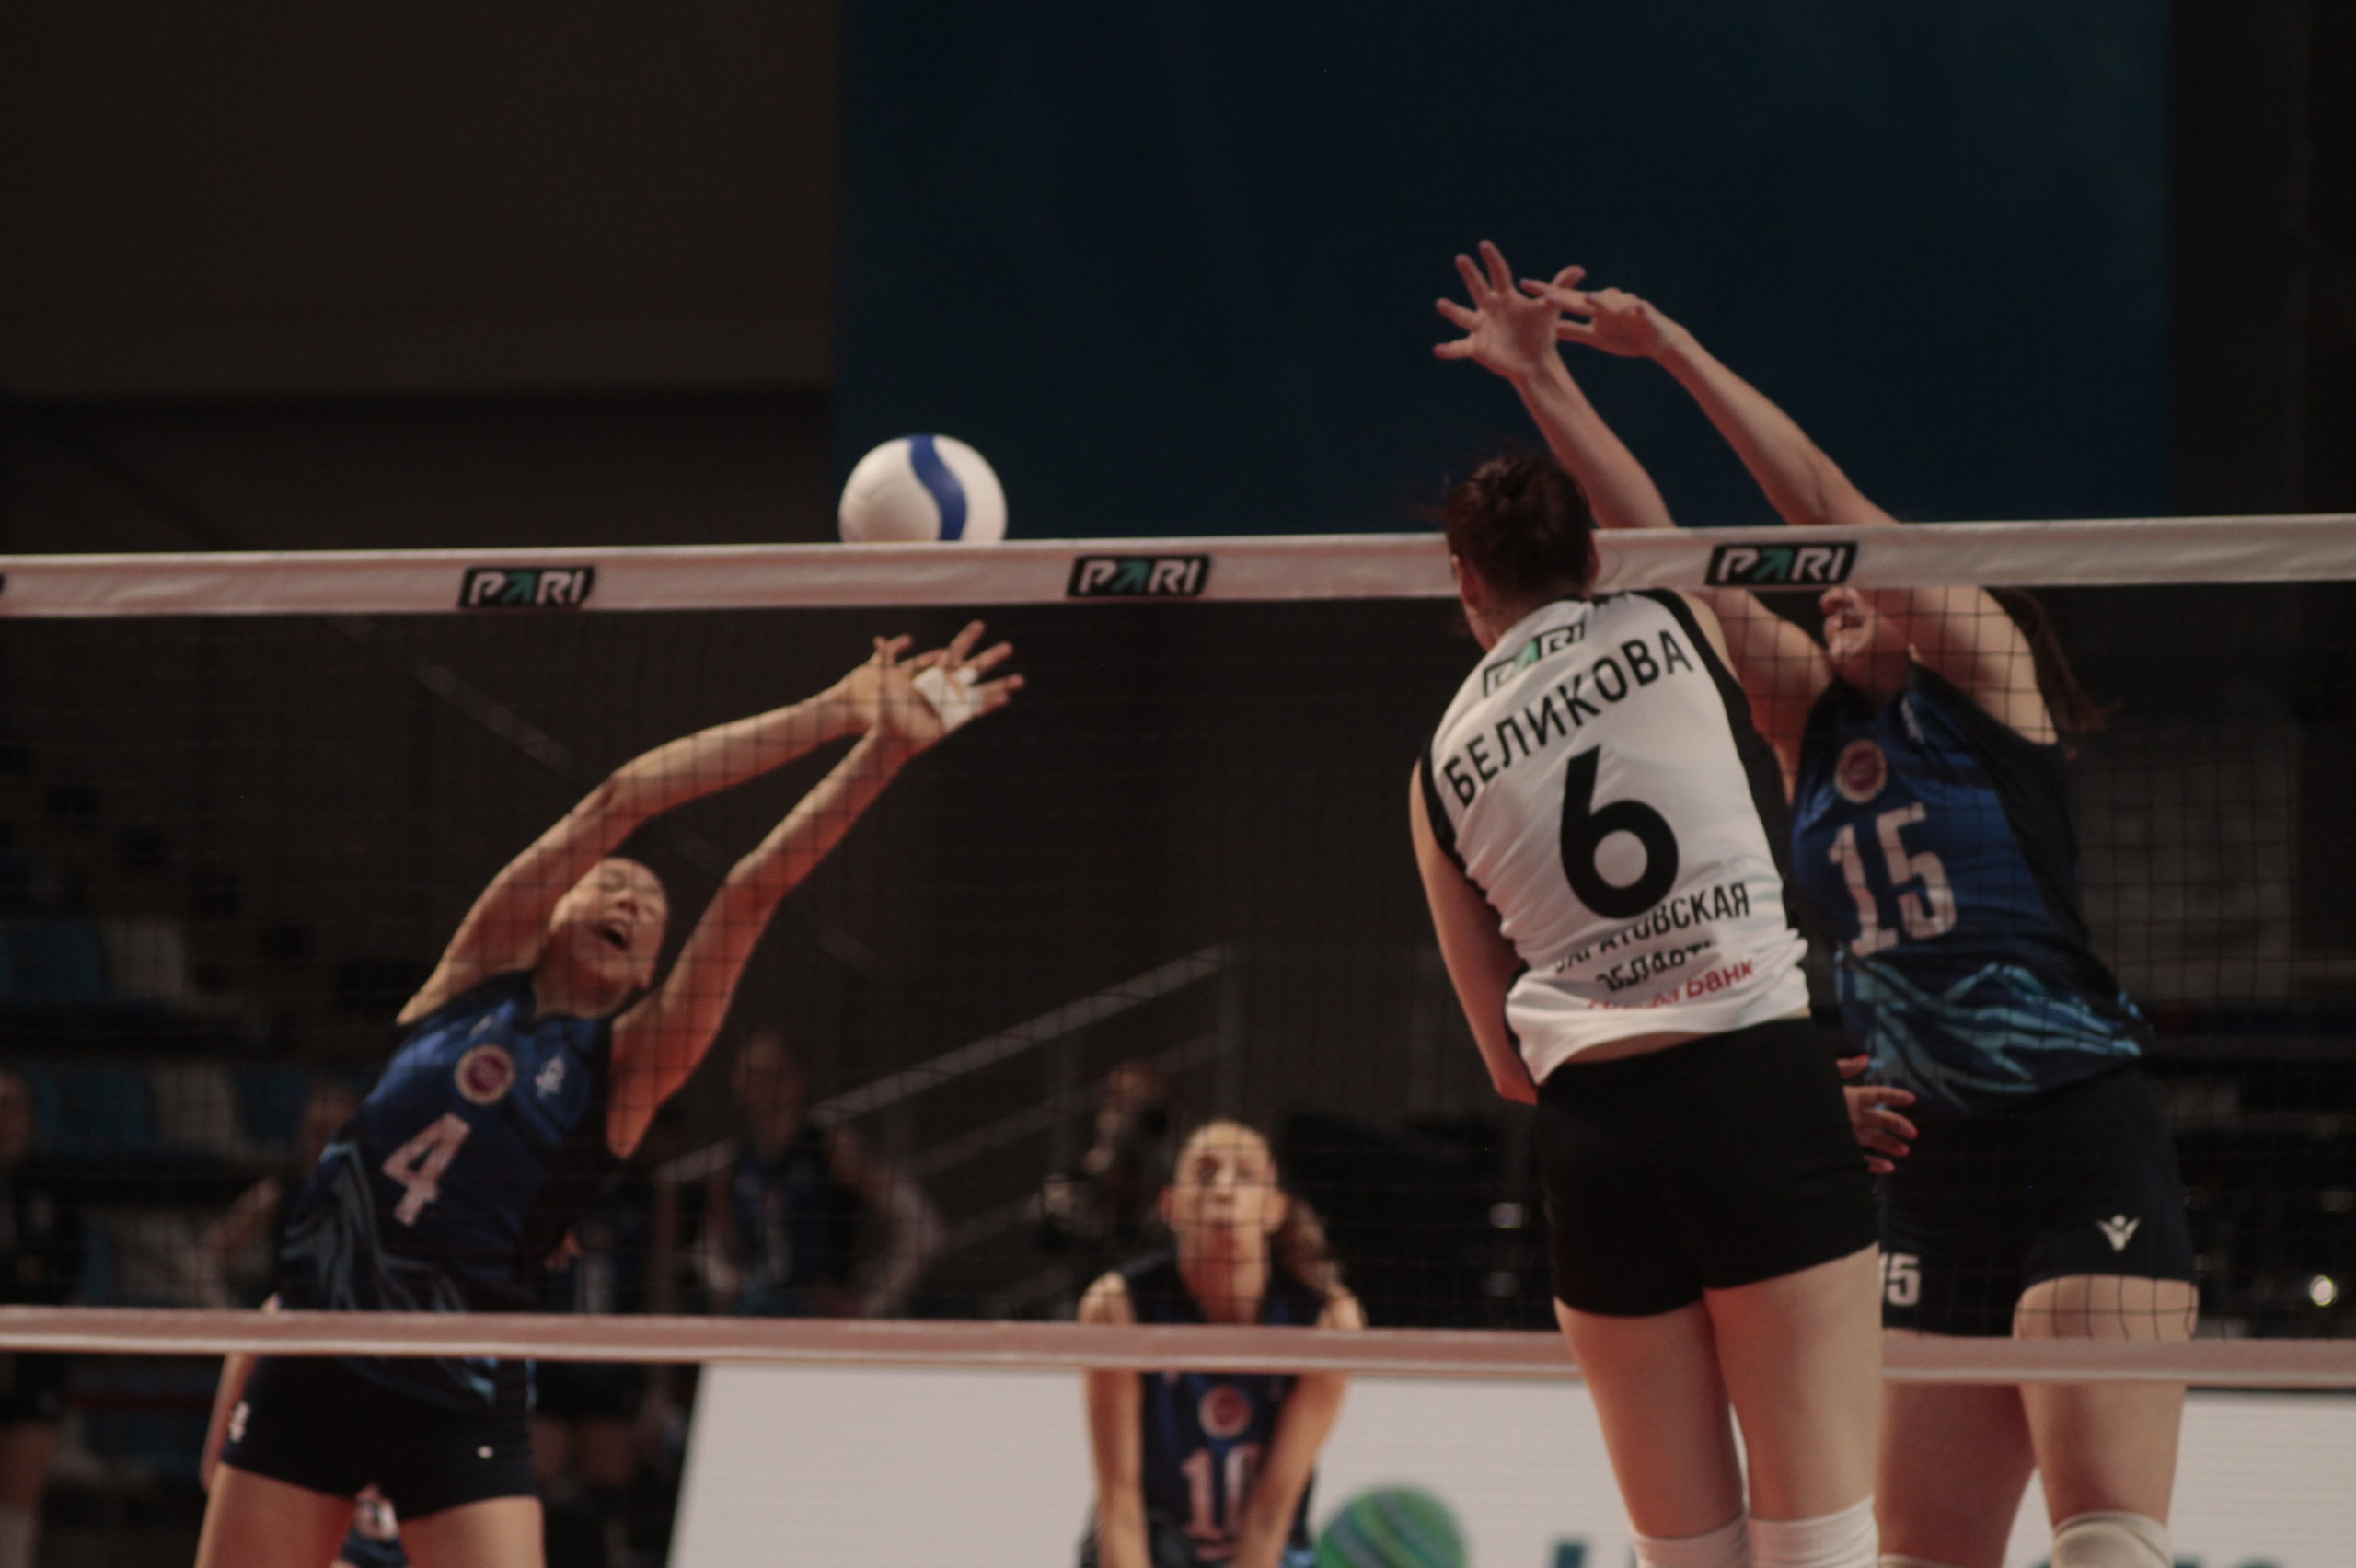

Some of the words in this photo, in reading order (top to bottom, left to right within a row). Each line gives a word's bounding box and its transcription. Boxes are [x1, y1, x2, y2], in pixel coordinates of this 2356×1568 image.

[468, 569, 587, 605] PARI
[1077, 559, 1201, 594] PARI
[1717, 547, 1846, 582] PARI
[1444, 630, 1694, 808] БЕЛИКОВА
[1560, 744, 1679, 918] 6
[1828, 801, 1958, 958] 15
[1555, 882, 1750, 974] ОВСКАЯ
[381, 1112, 472, 1228] 4
